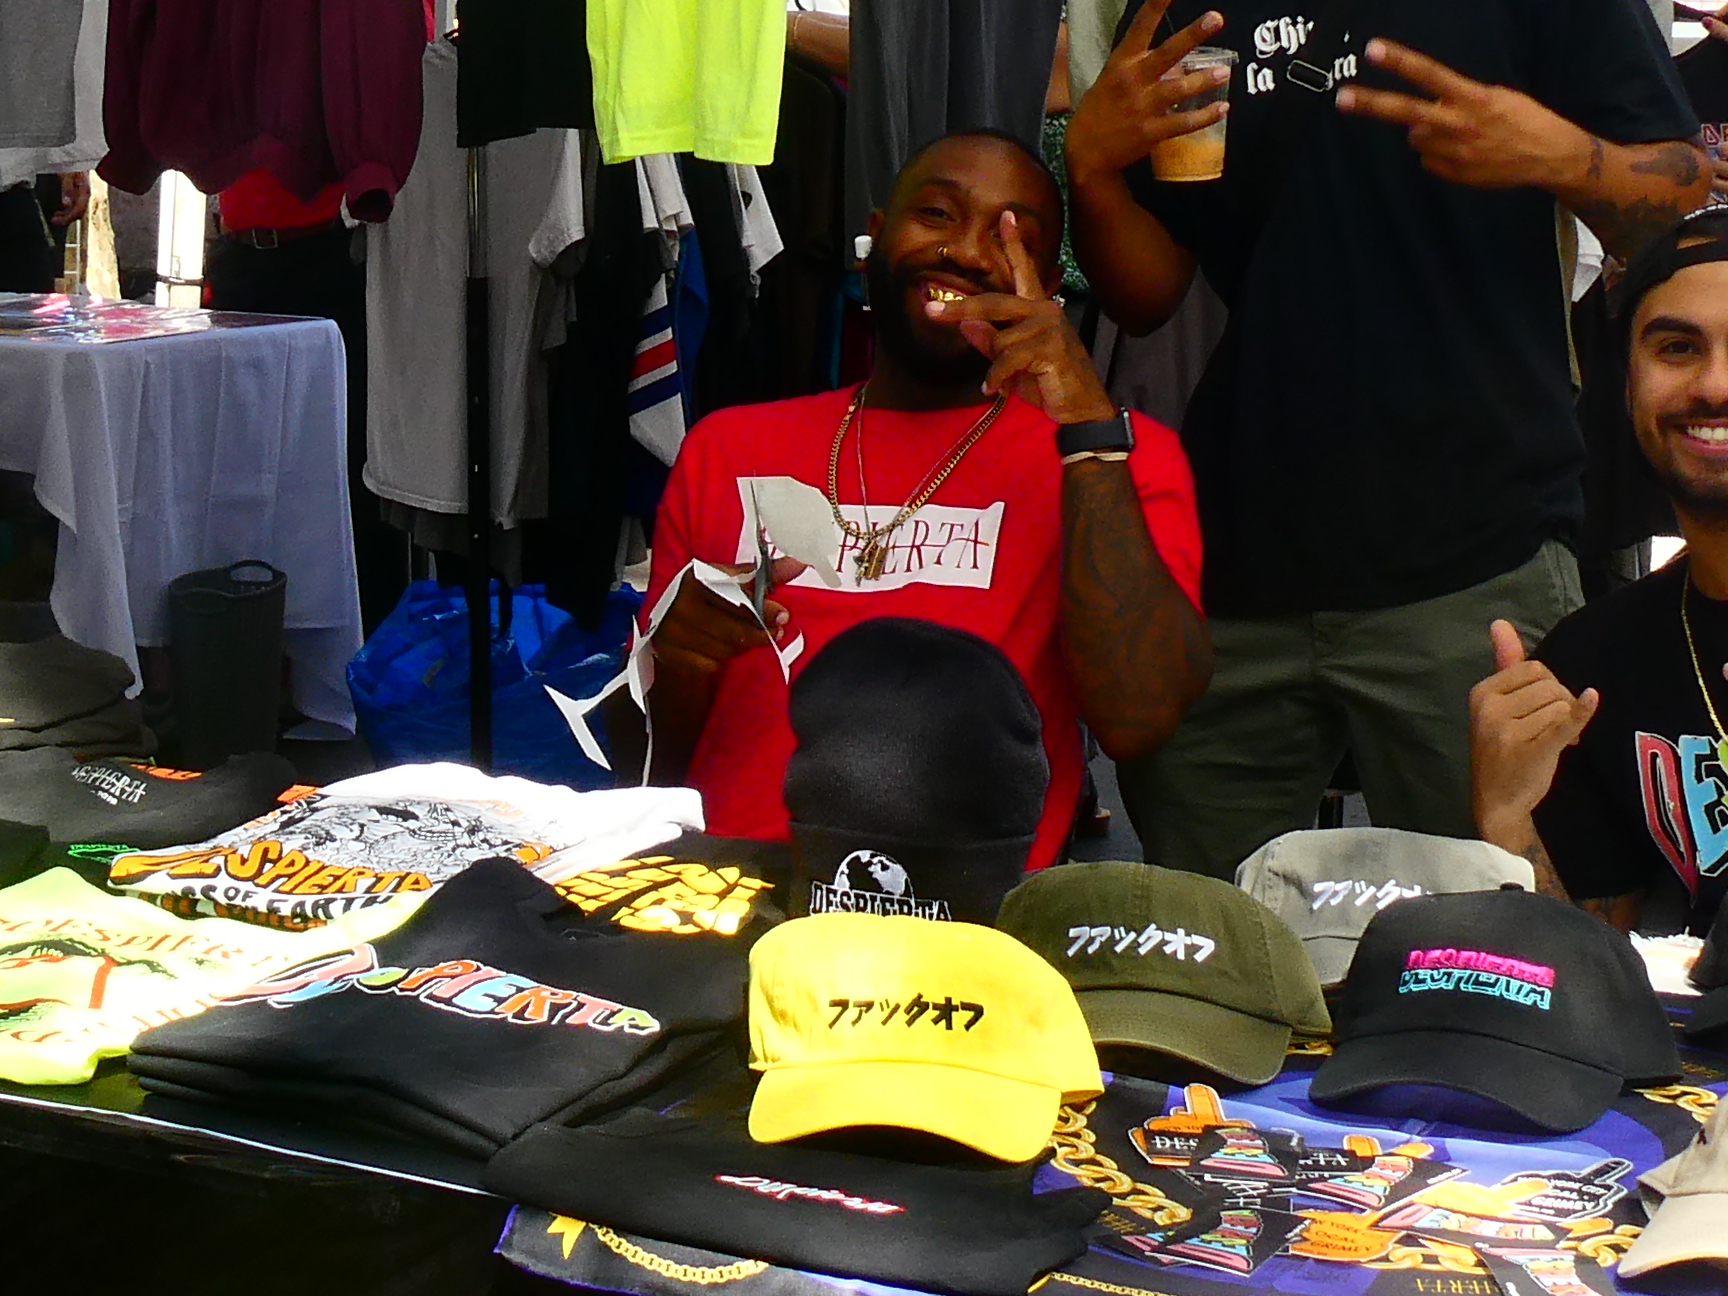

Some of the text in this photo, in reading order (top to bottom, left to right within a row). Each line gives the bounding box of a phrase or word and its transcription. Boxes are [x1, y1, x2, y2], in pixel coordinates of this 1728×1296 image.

[759, 514, 991, 577] PERTA
[223, 885, 258, 903] OF
[809, 880, 953, 922] DESPIERTA
[1415, 1278, 1493, 1295] IERTA
